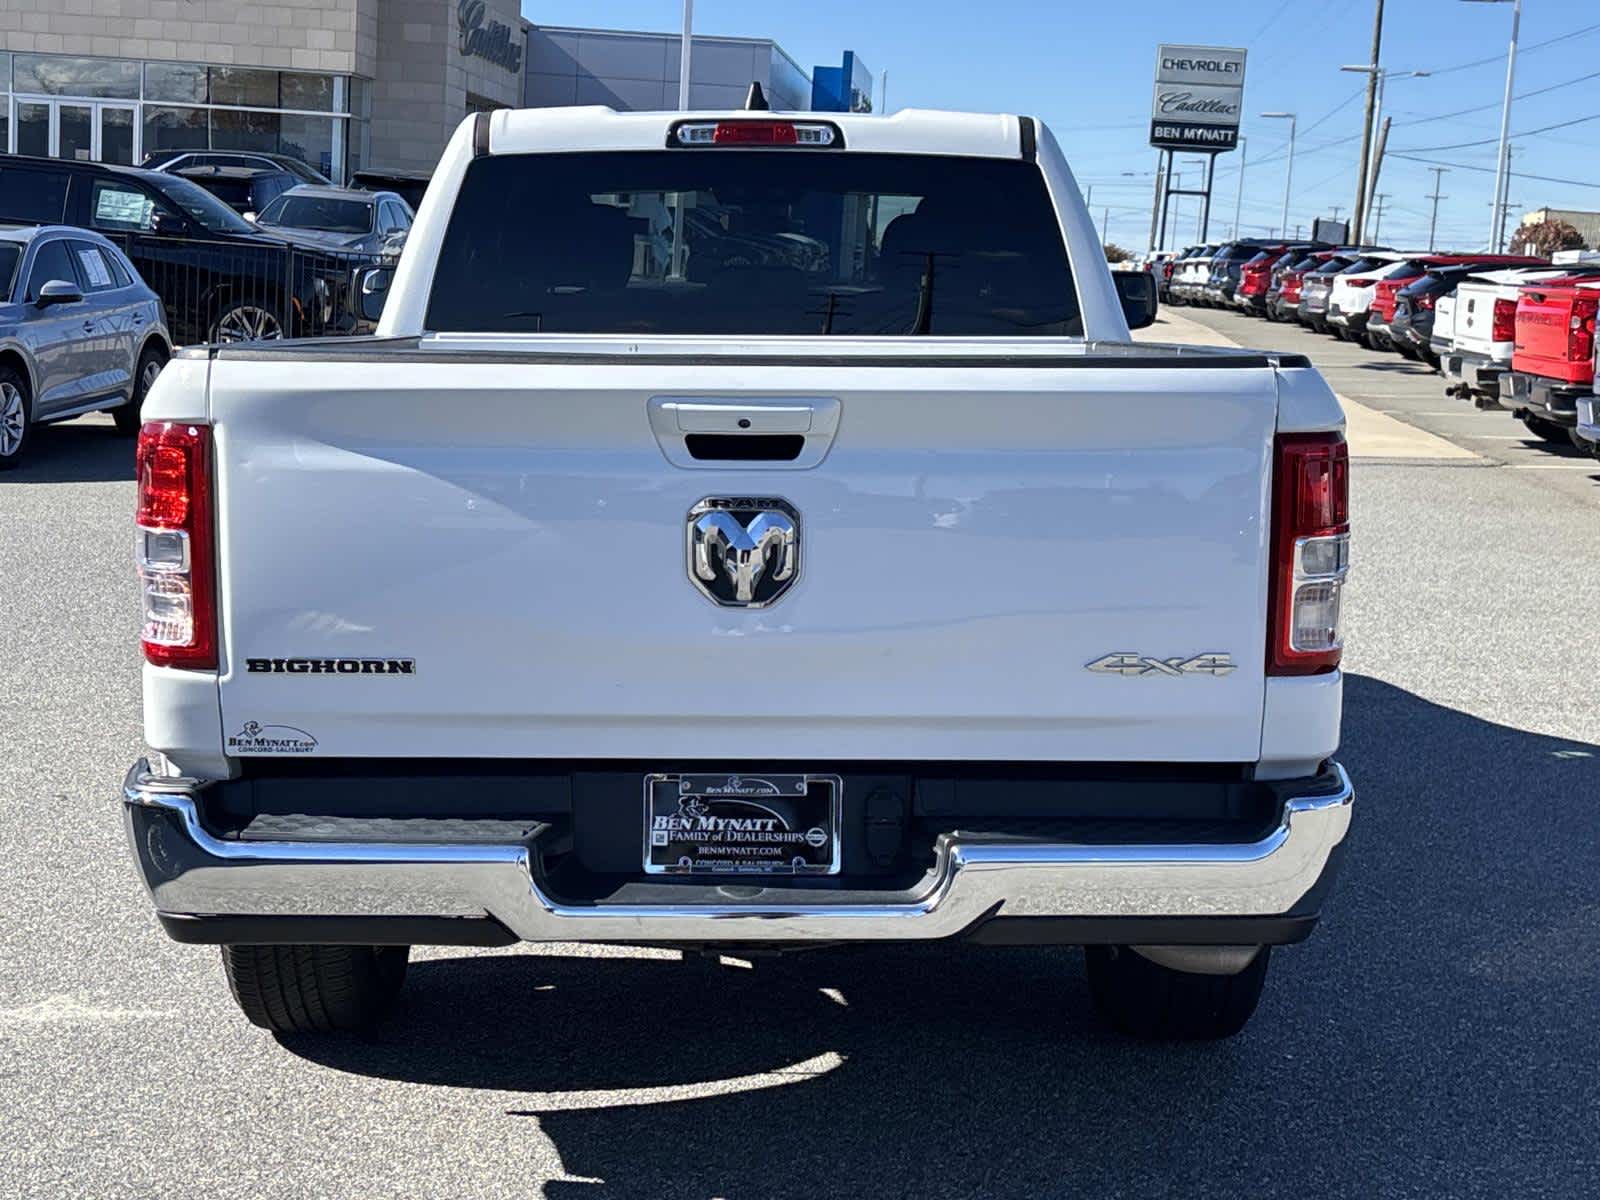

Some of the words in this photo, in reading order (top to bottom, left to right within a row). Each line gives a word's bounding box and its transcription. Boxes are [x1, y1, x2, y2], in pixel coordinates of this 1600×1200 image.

[1162, 58, 1241, 73] CHEVROLET
[1159, 92, 1237, 114] Cadillac
[1154, 126, 1180, 138] BEN
[1184, 128, 1235, 141] MYNATT
[246, 658, 415, 675] BIGHORN
[653, 816, 693, 831] BEN
[697, 816, 778, 832] MYNATT
[669, 832, 709, 842] FAMILY
[711, 832, 723, 842] of
[726, 831, 804, 842] DEALERSHIPS
[698, 847, 782, 856] BENMYNATT.COM
